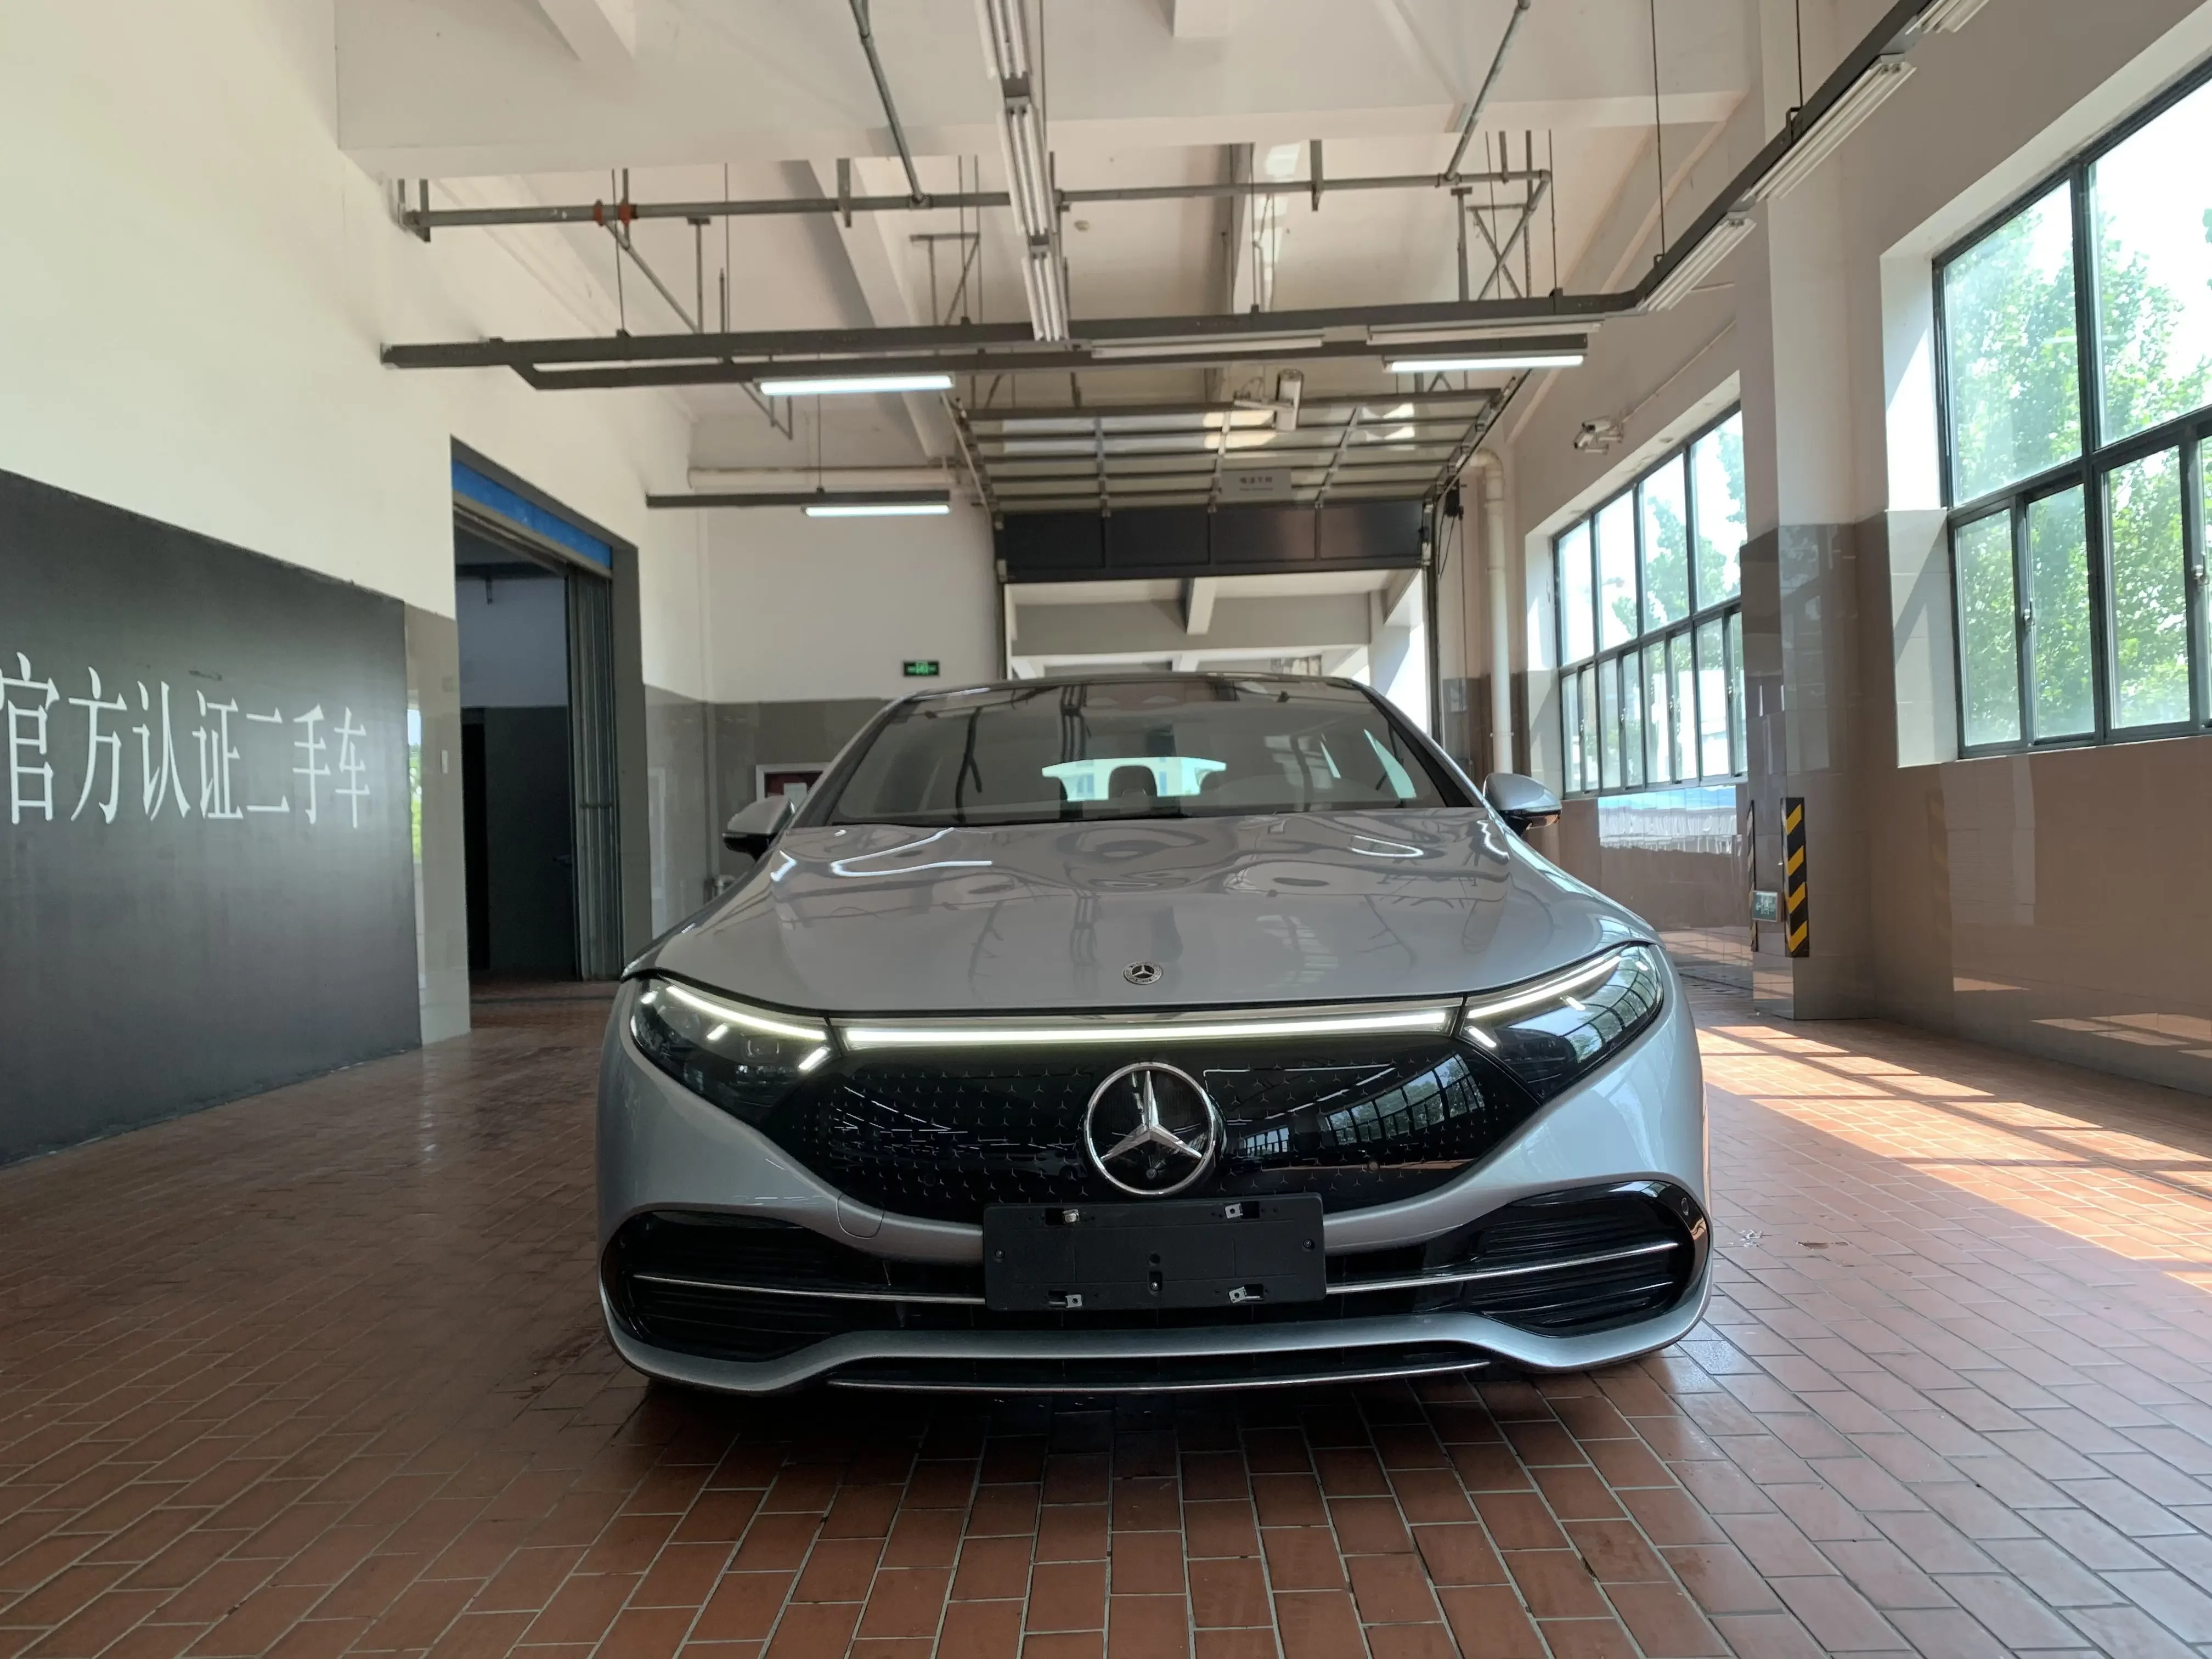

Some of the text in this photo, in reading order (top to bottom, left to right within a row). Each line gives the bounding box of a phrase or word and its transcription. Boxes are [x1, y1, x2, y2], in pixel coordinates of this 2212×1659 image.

[0, 652, 370, 828] 官方认证二手车
